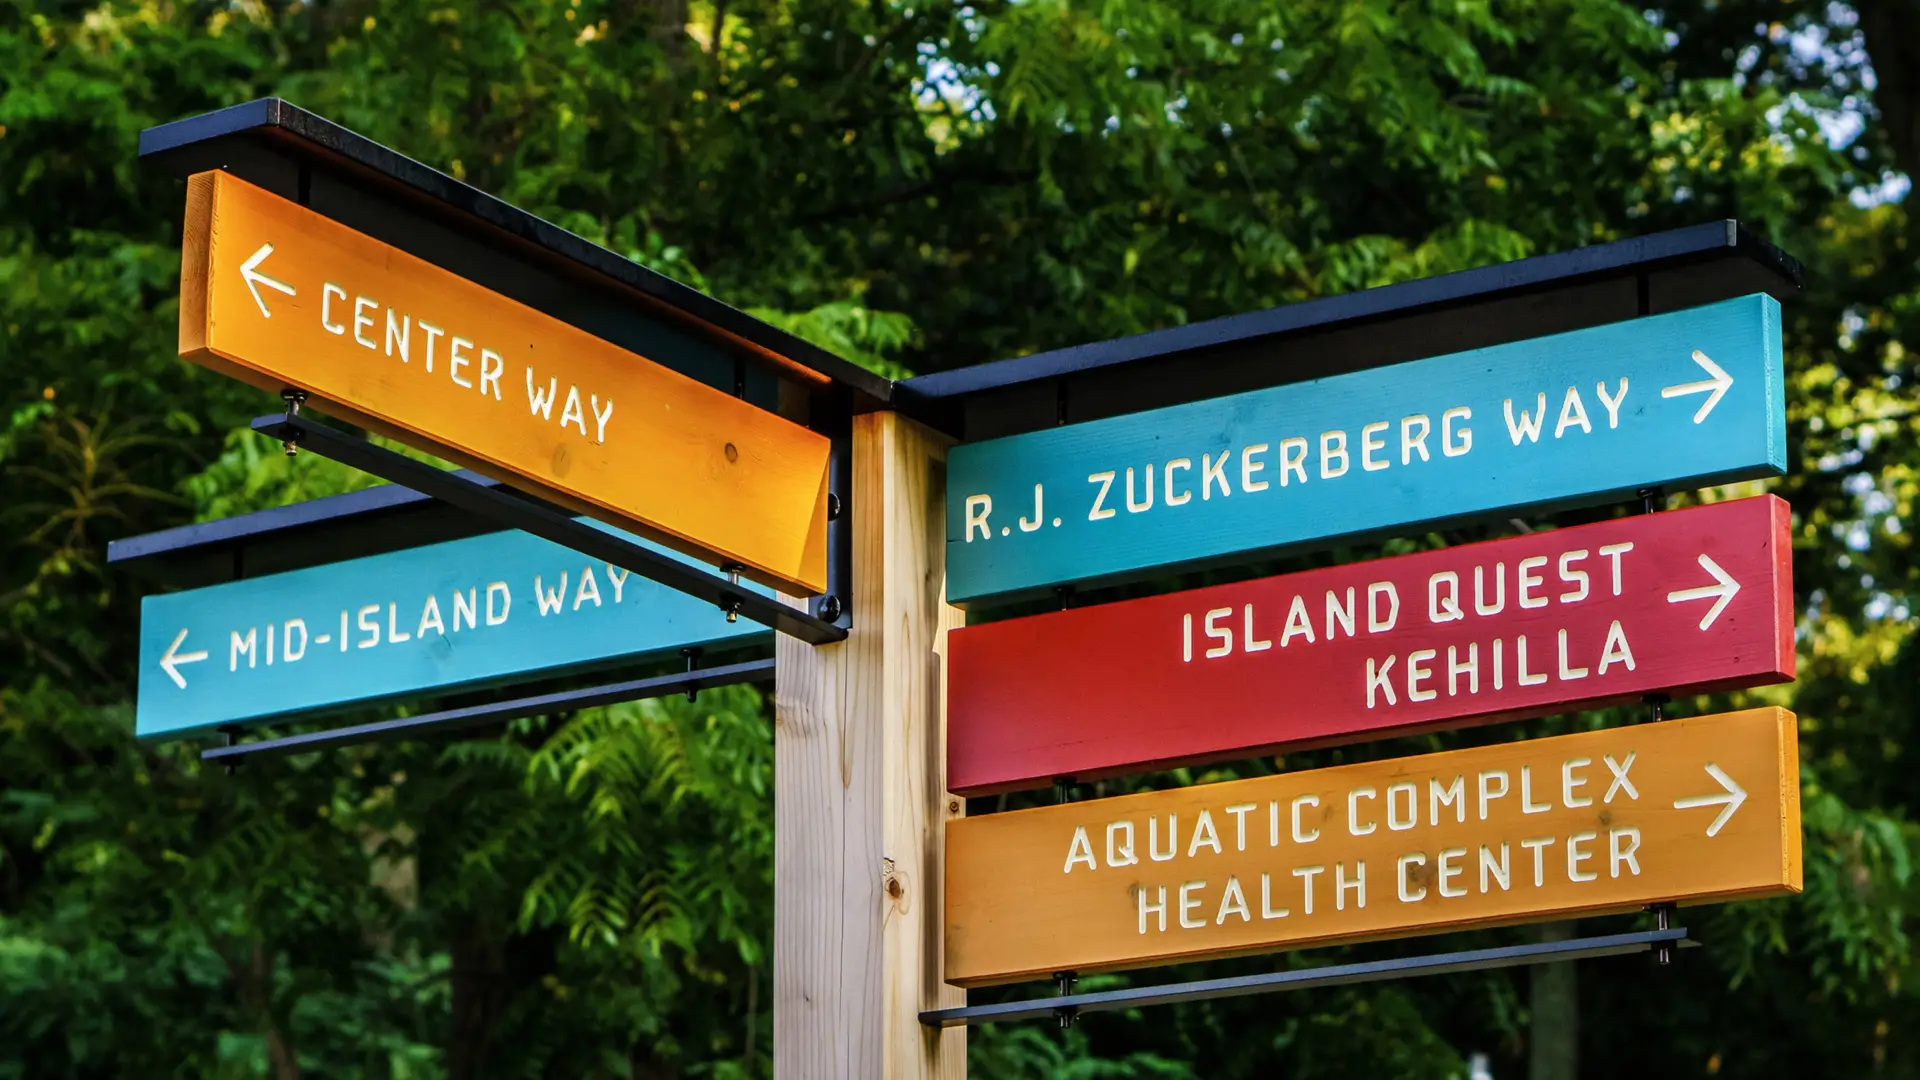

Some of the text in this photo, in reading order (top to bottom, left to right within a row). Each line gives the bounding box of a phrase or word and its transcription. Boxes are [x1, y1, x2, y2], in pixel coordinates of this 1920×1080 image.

[321, 283, 614, 443] CENTER WAY
[964, 376, 1631, 543] R.J. ZUCKERBERG WAY
[229, 562, 631, 672] MID-ISLAND WAY
[1183, 542, 1634, 663] ISLAND QUEST
[1366, 620, 1636, 709] KEHILLA
[1063, 752, 1640, 874] AQUATIC COMPLEX
[1138, 828, 1641, 935] HEALTH CENTER
